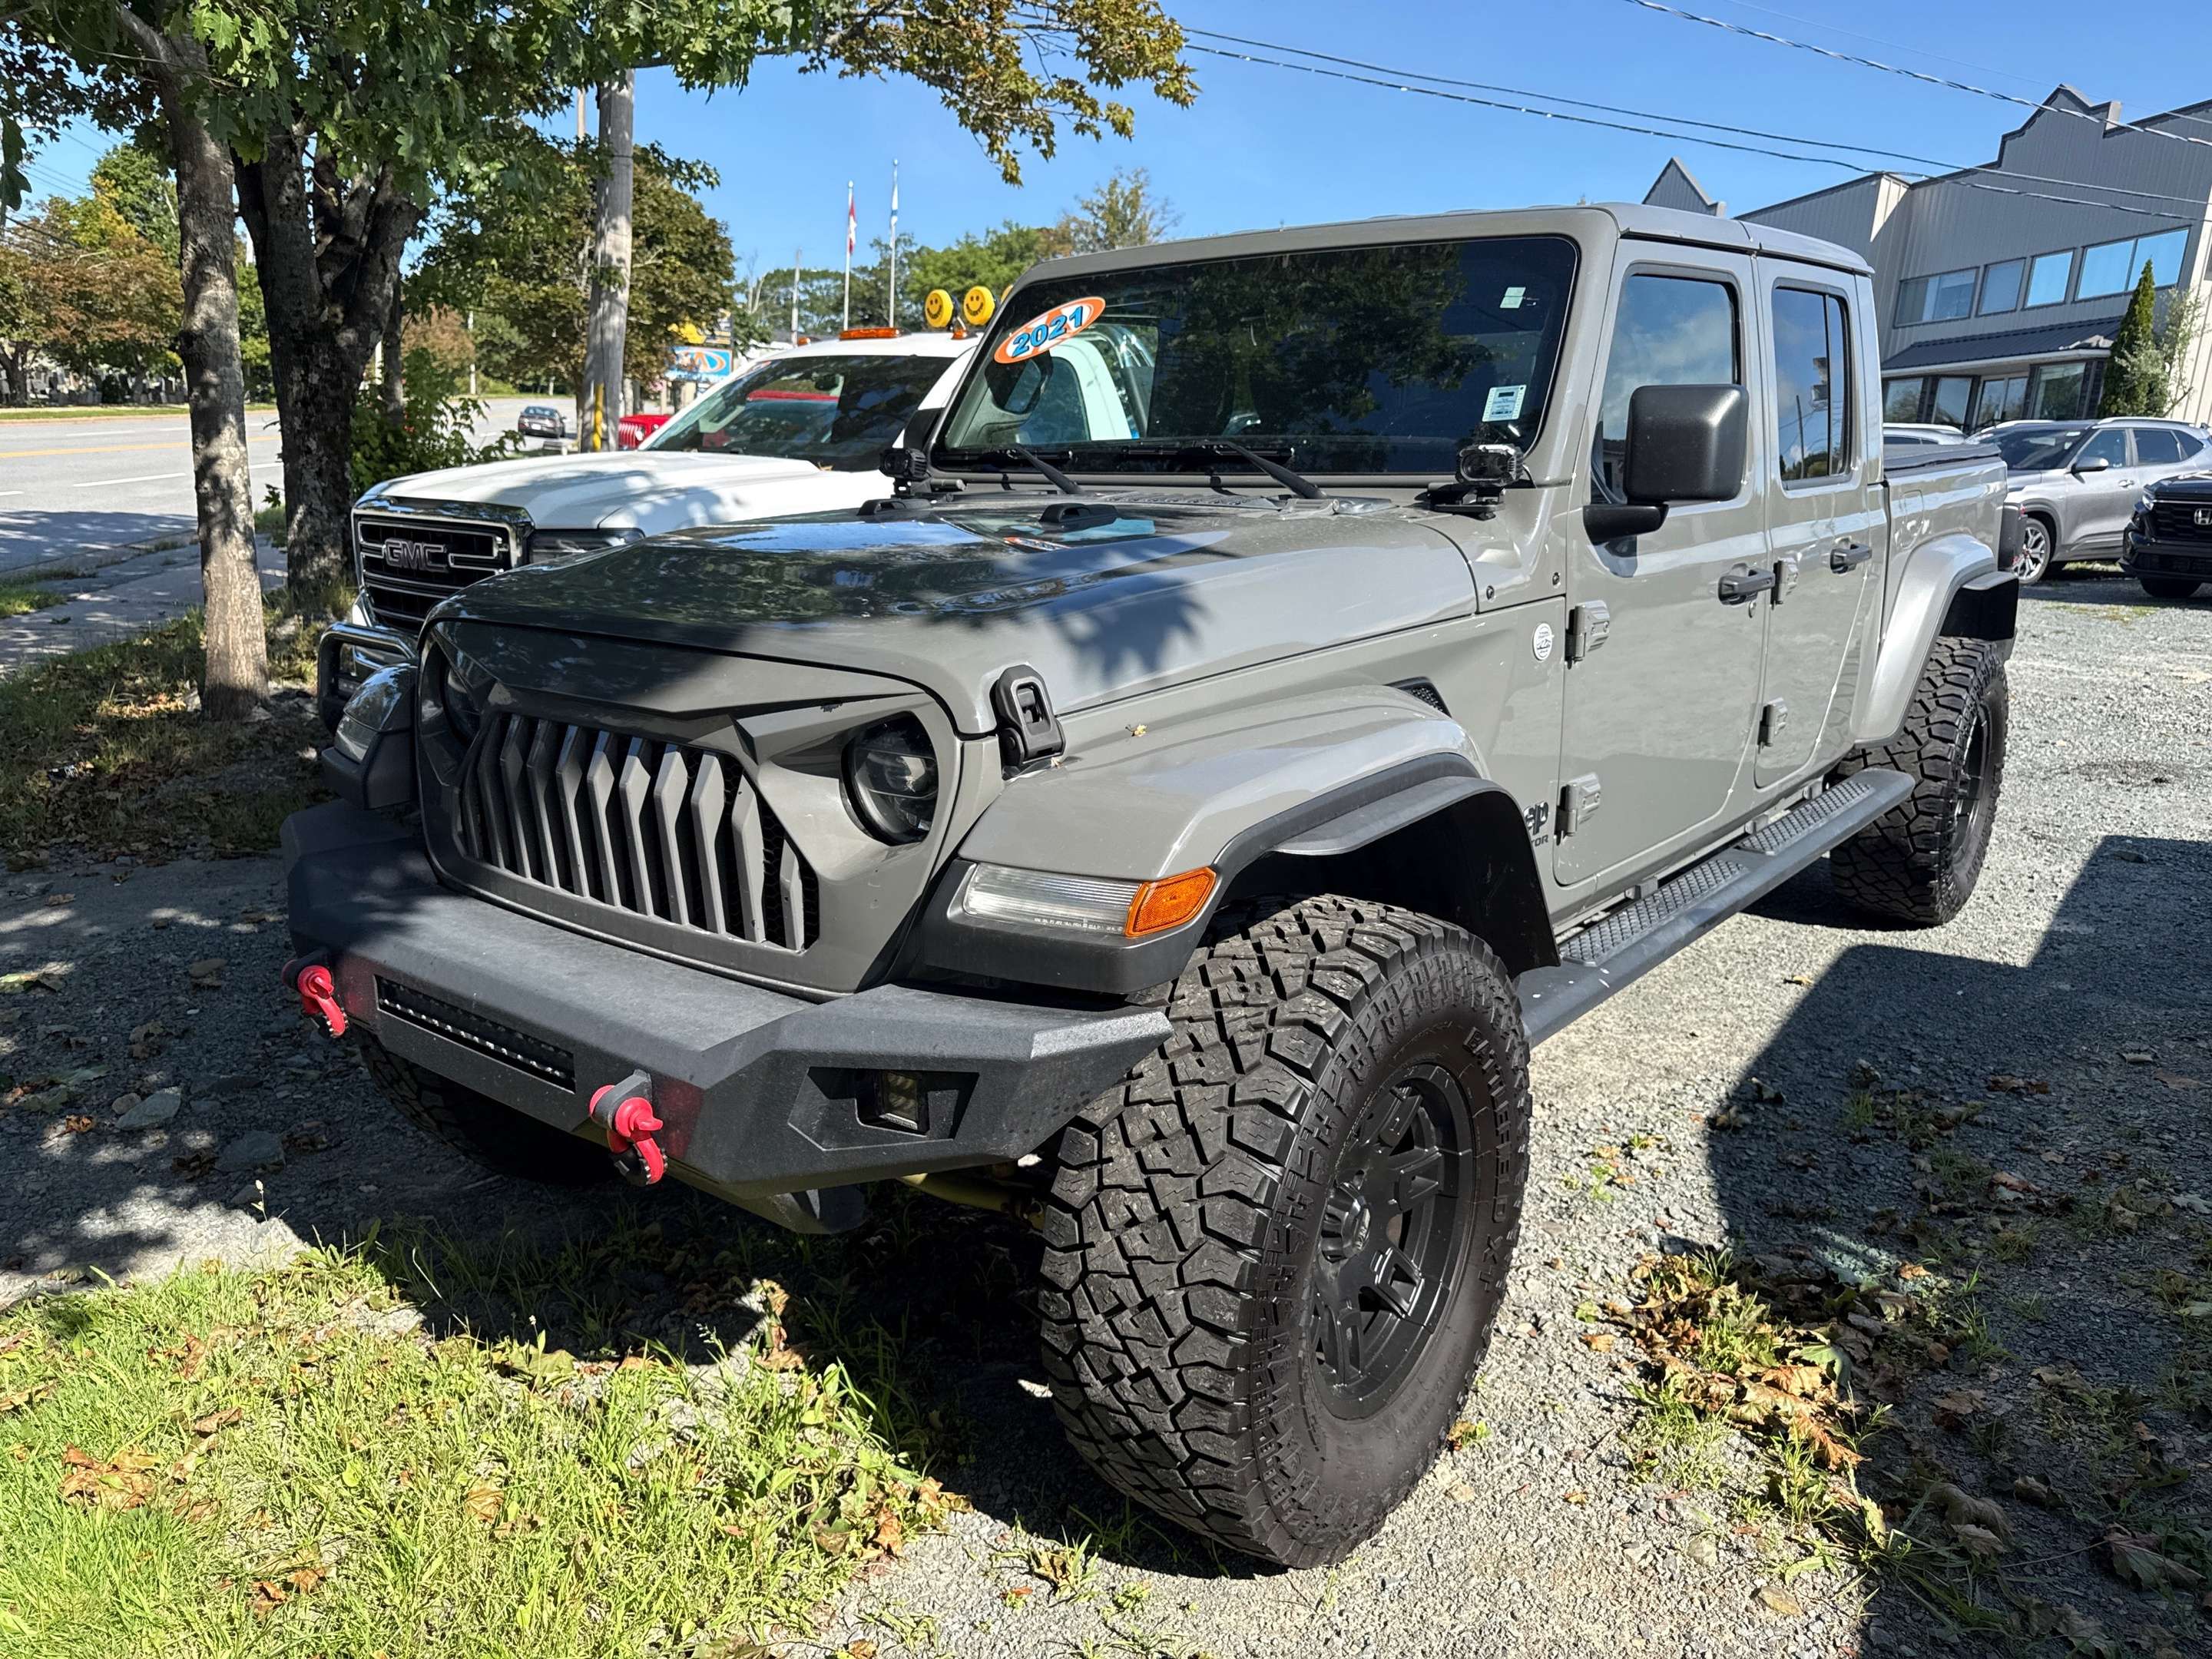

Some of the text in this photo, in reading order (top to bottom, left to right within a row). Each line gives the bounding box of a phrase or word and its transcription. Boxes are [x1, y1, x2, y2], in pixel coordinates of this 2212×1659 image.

[1012, 305, 1084, 359] 2021
[385, 538, 449, 573] GMC
[1523, 801, 1548, 836] ep
[1462, 1027, 1511, 1223] BATTLEFIELD
